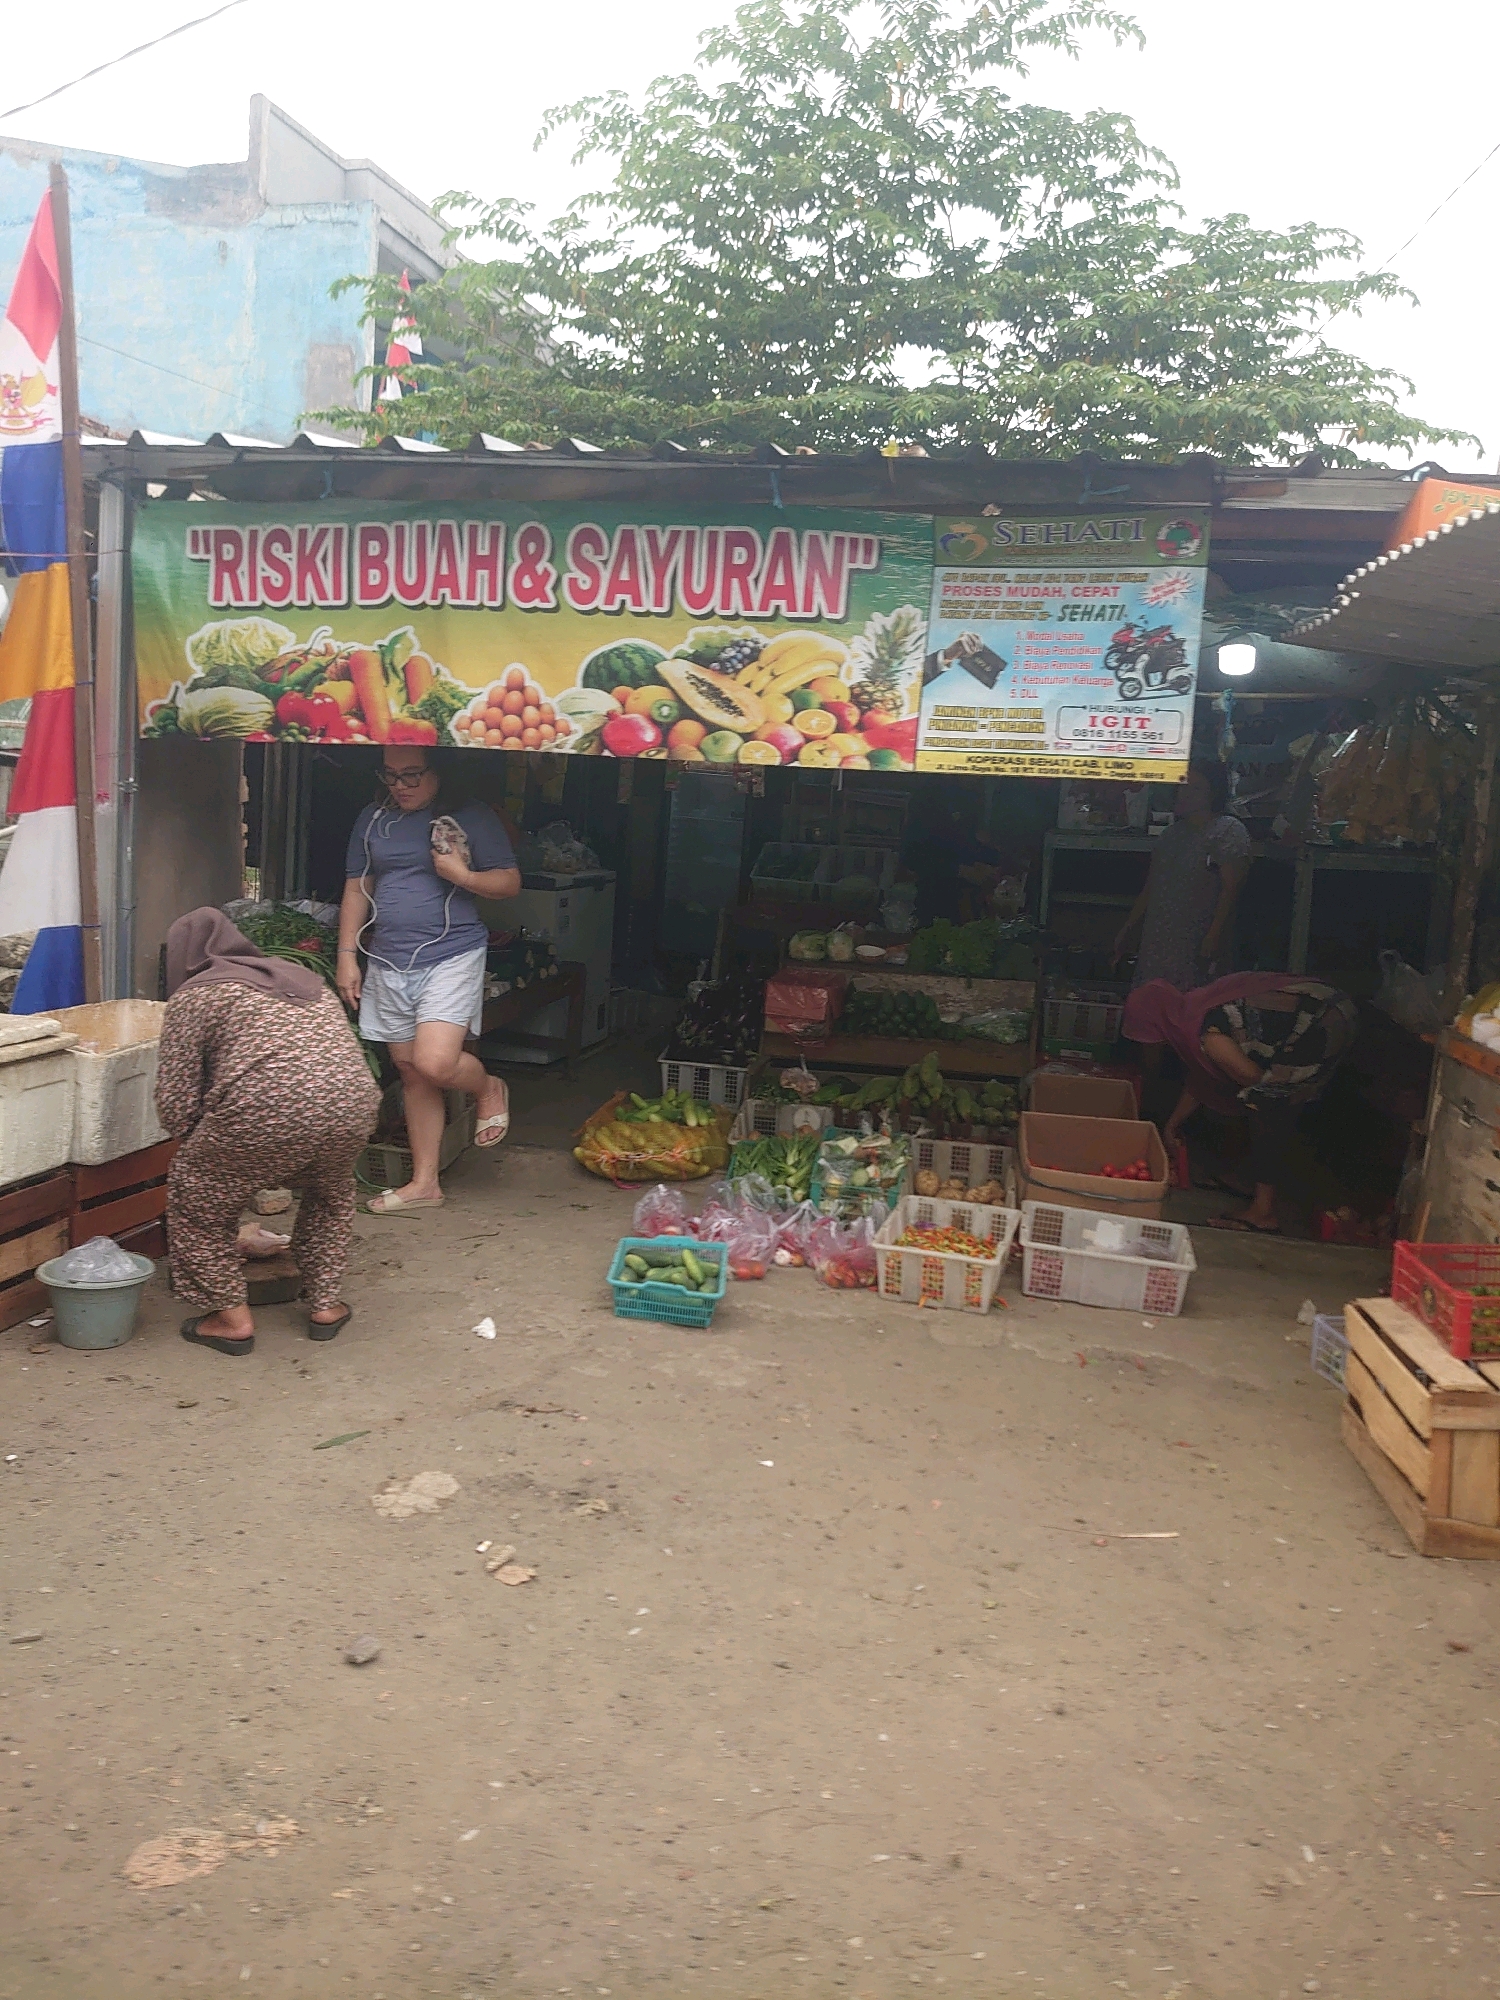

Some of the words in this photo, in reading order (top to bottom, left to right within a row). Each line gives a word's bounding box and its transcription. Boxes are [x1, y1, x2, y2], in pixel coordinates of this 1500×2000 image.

[992, 518, 1146, 546] SEHATI
[188, 523, 350, 609] "RISKI
[354, 521, 507, 610] BUAH
[510, 523, 557, 613] &
[563, 526, 880, 619] SAYURAN"
[942, 585, 1002, 597] PROSES
[1006, 585, 1066, 599] MUDAH,
[1071, 586, 1121, 597] CEPAT
[1088, 715, 1152, 730] IGIT
[1072, 728, 1105, 738] 0816
[1108, 730, 1139, 740] 1155
[966, 756, 1025, 767] KOPERASI
[1028, 758, 1071, 768] SEHATI
[1073, 759, 1102, 769] CAB.
[1104, 761, 1135, 770] LIMO
